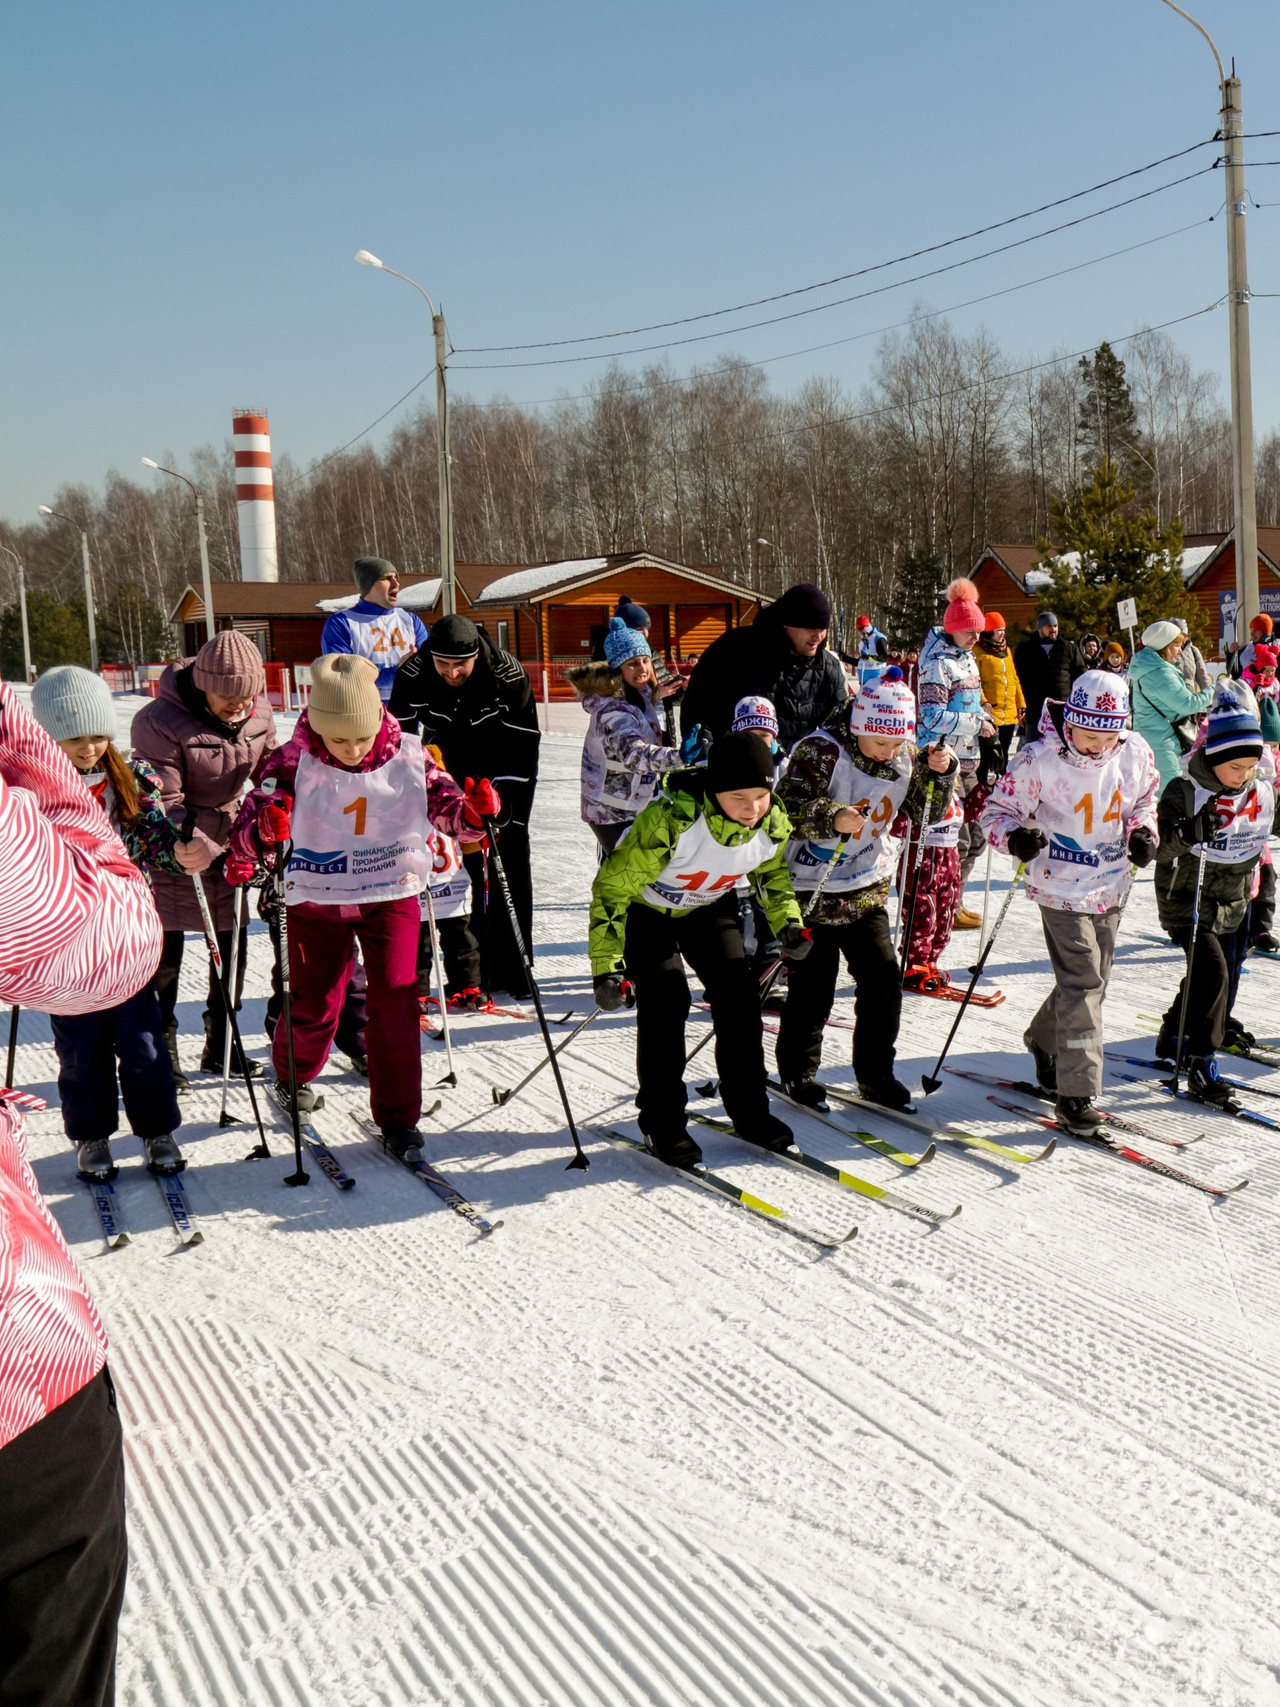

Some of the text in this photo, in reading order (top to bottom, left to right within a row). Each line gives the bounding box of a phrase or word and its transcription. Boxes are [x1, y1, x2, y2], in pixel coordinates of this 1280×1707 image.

[369, 627, 407, 652] 24
[867, 717, 905, 727] sochi
[1067, 711, 1122, 728] ЛЫЖНЯ
[864, 724, 905, 735] RUSSIA
[342, 796, 368, 836] 1
[1073, 787, 1123, 835] 14
[1213, 788, 1262, 830] 54
[1051, 849, 1097, 865] ИНВЕСТ
[290, 861, 344, 873] ИНВЕСТ
[352, 860, 397, 875] КОМПАНИЯ
[421, 889, 450, 900] ИВЕСТ
